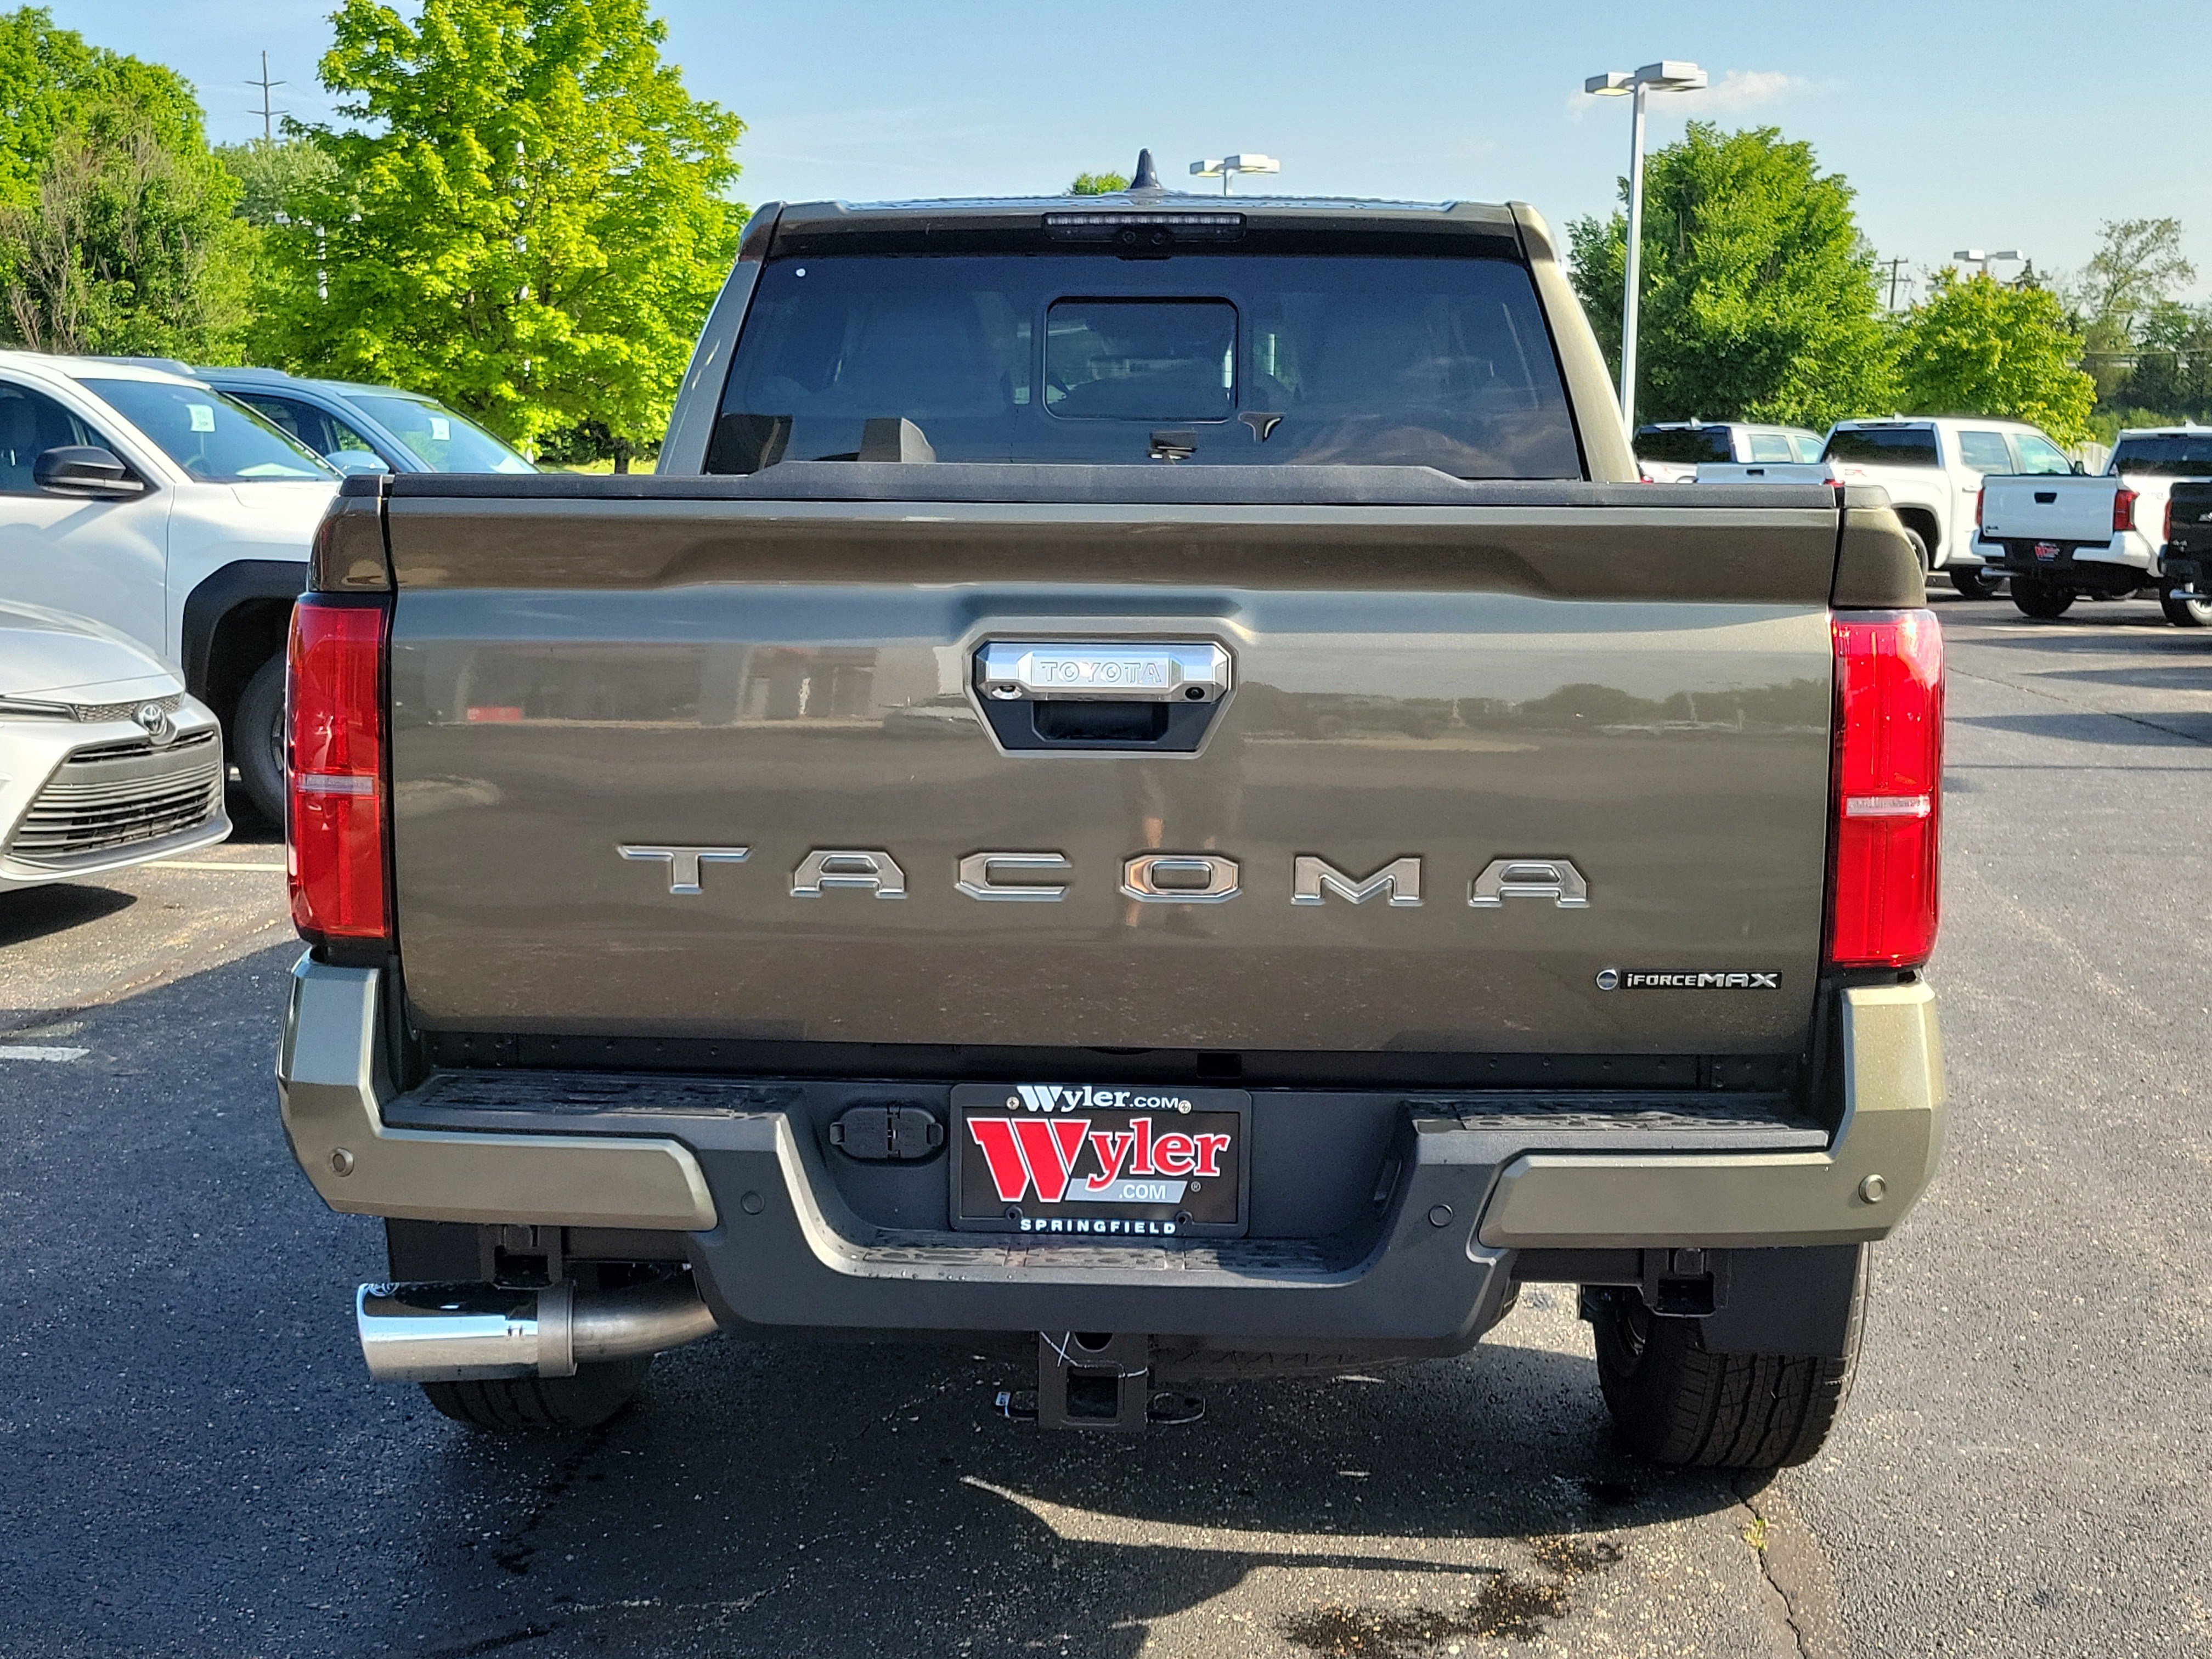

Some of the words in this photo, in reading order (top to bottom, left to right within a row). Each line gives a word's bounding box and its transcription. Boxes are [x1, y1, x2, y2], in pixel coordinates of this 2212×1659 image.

[1040, 661, 1163, 684] TOYOTA
[616, 844, 1592, 909] TACOMA
[966, 1117, 1231, 1203] Wyler
[1020, 1218, 1176, 1234] SPRINGFIELD
